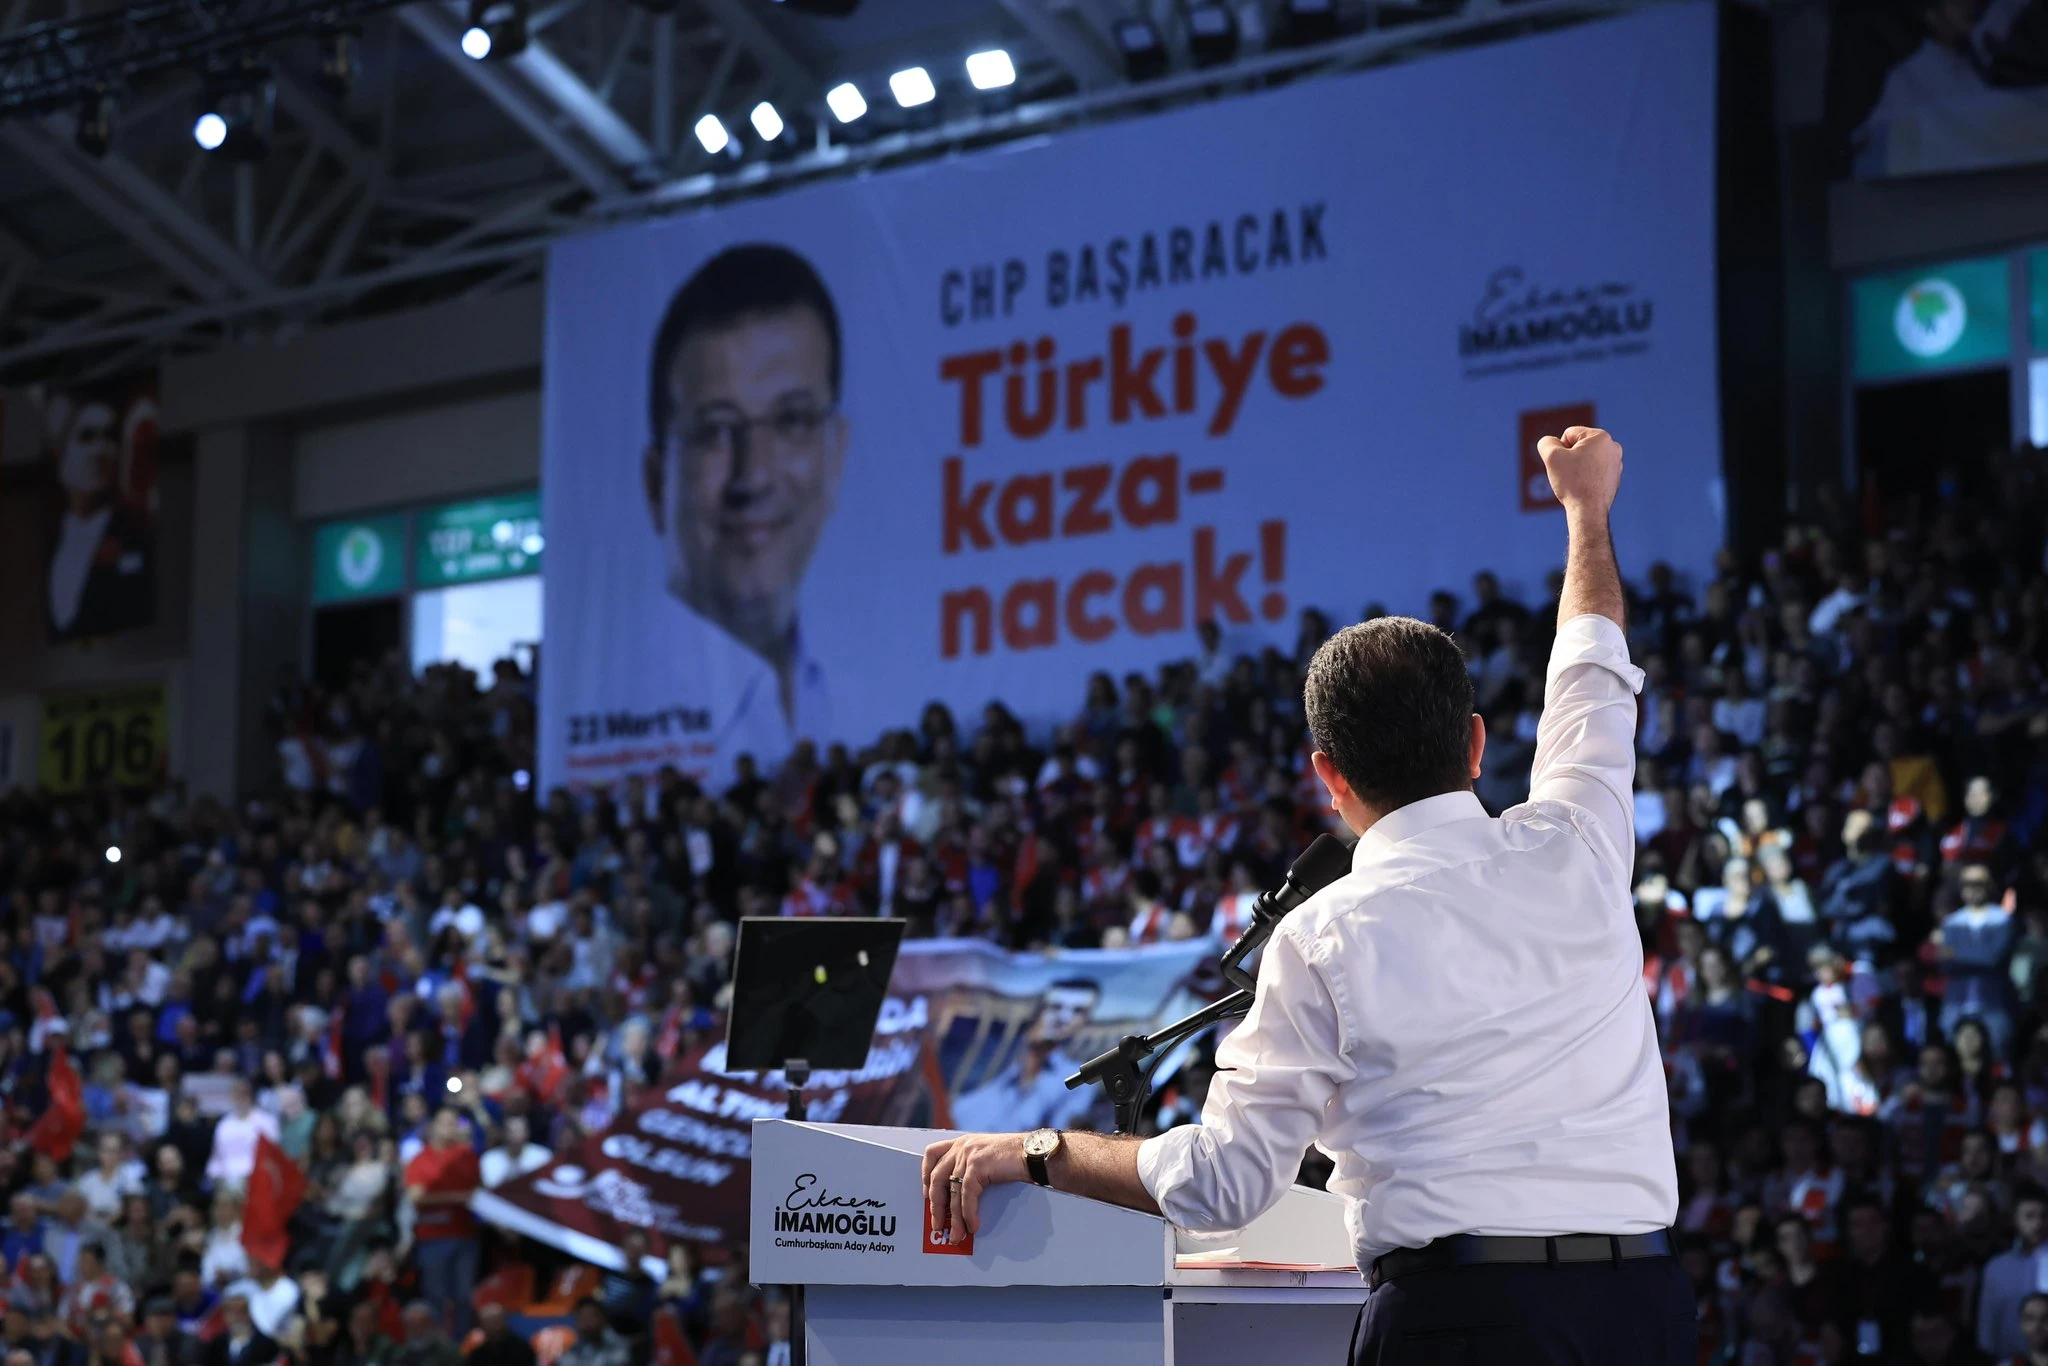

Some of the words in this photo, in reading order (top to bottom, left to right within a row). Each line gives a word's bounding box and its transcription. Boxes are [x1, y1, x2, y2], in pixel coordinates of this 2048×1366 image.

[941, 259, 1028, 328] CHP
[1047, 203, 1328, 309] BAŞARACAK
[940, 311, 1331, 447] Türkiye
[941, 453, 1226, 555] kaza-
[940, 519, 1287, 660] nacak!
[48, 713, 156, 783] 106
[774, 1206, 897, 1236] İMAMOĞLU
[786, 1173, 887, 1211] Ekrem
[775, 1237, 842, 1251] Cumhurbaşkanı
[843, 1240, 868, 1253] Aday
[868, 1241, 895, 1254] Adayı
